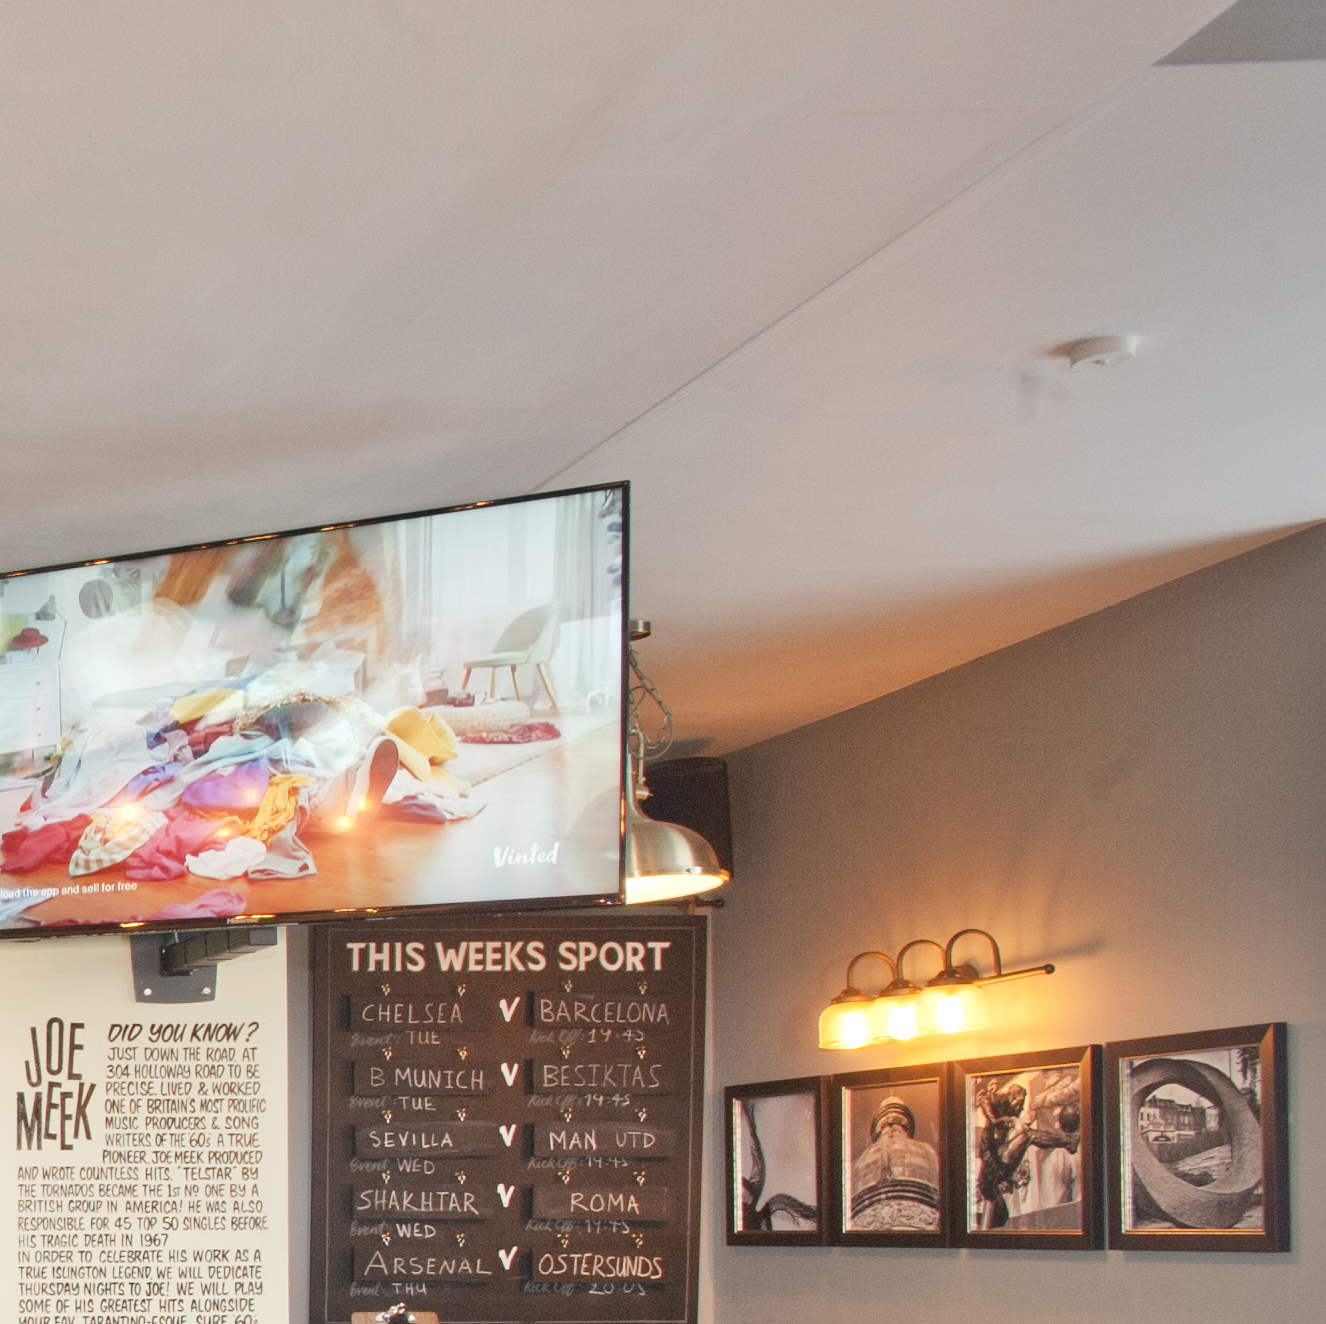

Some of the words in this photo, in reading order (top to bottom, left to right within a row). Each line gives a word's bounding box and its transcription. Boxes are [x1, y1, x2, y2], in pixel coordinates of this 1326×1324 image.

[494, 841, 559, 867] Vinted
[22, 888, 39, 898] the
[41, 887, 59, 899] app
[61, 885, 80, 895] and
[81, 883, 99, 894] sell
[101, 882, 115, 893] for
[117, 881, 138, 892] free
[347, 942, 425, 971] THIS
[436, 941, 546, 971] WEEKS
[559, 941, 670, 971] SPORT
[362, 1003, 463, 1023] CHELSEA
[540, 999, 669, 1025] BARCELONA
[108, 1024, 143, 1042] DID
[148, 1024, 187, 1042] YOU
[406, 1031, 440, 1045] TUE
[25, 1017, 85, 1087] JOE
[108, 1047, 138, 1060] JUST
[144, 1048, 178, 1061] DOWN
[183, 1047, 200, 1061] THE
[243, 1047, 258, 1061] AT
[107, 1064, 130, 1078] 304
[135, 1064, 190, 1078] HOLLOWAY
[195, 1064, 225, 1078] ROAD
[228, 1064, 241, 1078] TO
[246, 1064, 259, 1079] BE
[395, 1067, 484, 1089] MUNICH
[542, 1064, 662, 1088] BESIKTAS
[161, 1082, 192, 1096] LIVED
[198, 1082, 208, 1095] &
[212, 1082, 260, 1096] WORKED
[105, 1099, 125, 1114] ONE
[130, 1099, 142, 1114] OF
[200, 1098, 224, 1113] MOST
[228, 1098, 266, 1113] PROLIFIC
[398, 1097, 436, 1111] TUE
[16, 1081, 97, 1151] MEEK
[106, 1116, 138, 1130] MUSIC
[146, 1116, 206, 1130] PRODUCERS
[212, 1117, 220, 1129] &
[225, 1116, 258, 1129] SONG
[369, 1131, 454, 1148] SEVILLA
[549, 1129, 597, 1150] MAN
[616, 1132, 656, 1148] UTD
[152, 1151, 172, 1164] JOE
[175, 1151, 204, 1164] MEEK
[208, 1151, 262, 1164] PRODUCED
[18, 1166, 38, 1180] AND
[42, 1166, 74, 1180] WROTE
[80, 1167, 138, 1180] COUNTLESS
[242, 1167, 258, 1180] BY
[398, 1158, 436, 1175] WED
[18, 1200, 62, 1212] BRITISH
[68, 1200, 102, 1213] GROUP
[107, 1201, 117, 1212] IN
[126, 1200, 182, 1214] AMERICA!
[189, 1200, 201, 1213] HE
[206, 1200, 226, 1213] WAS
[234, 1200, 262, 1213] ALSO
[357, 1189, 479, 1215] SHAKHTAR
[570, 1192, 640, 1215] ROMA
[18, 1217, 85, 1231] RESPONSIBLE
[91, 1217, 109, 1230] FOR
[114, 1217, 132, 1230] 45
[138, 1217, 157, 1230] TOP
[163, 1216, 178, 1230] 50
[183, 1216, 226, 1230] SINGLES
[231, 1216, 267, 1231] BEFORE
[396, 1222, 436, 1239] WED
[19, 1235, 36, 1248] HIS
[40, 1234, 78, 1247] TRAGIC
[84, 1234, 116, 1247] DEATH
[122, 1234, 132, 1247] IN
[140, 1234, 168, 1247] 1967
[18, 1251, 29, 1262] IN
[35, 1251, 73, 1263] ORDER
[78, 1250, 92, 1263] TO
[100, 1250, 163, 1263] CELEBRATE
[169, 1250, 187, 1262] HIS
[193, 1250, 230, 1262] WORK
[235, 1249, 248, 1262] AS
[254, 1249, 261, 1262] A
[18, 1266, 47, 1279] TRUE
[52, 1266, 106, 1279] ISLINGTON
[156, 1267, 172, 1279] WE
[178, 1267, 203, 1279] WILL
[208, 1266, 262, 1279] DEDICATE
[539, 1253, 663, 1279] OSTERSUNDS
[19, 1282, 79, 1296] THURSDAY
[84, 1282, 124, 1296] NIGHTS
[128, 1282, 141, 1296] TO
[146, 1282, 169, 1296] JOE!
[177, 1282, 194, 1296] WE
[201, 1282, 228, 1296] WILL
[235, 1282, 262, 1295] PLAY
[19, 1299, 50, 1313] SOME
[56, 1299, 69, 1313] OF
[75, 1299, 94, 1312] HIS
[100, 1299, 153, 1312] GREATEST
[159, 1299, 184, 1312] HITS
[191, 1298, 254, 1312] ALONGSIDE
